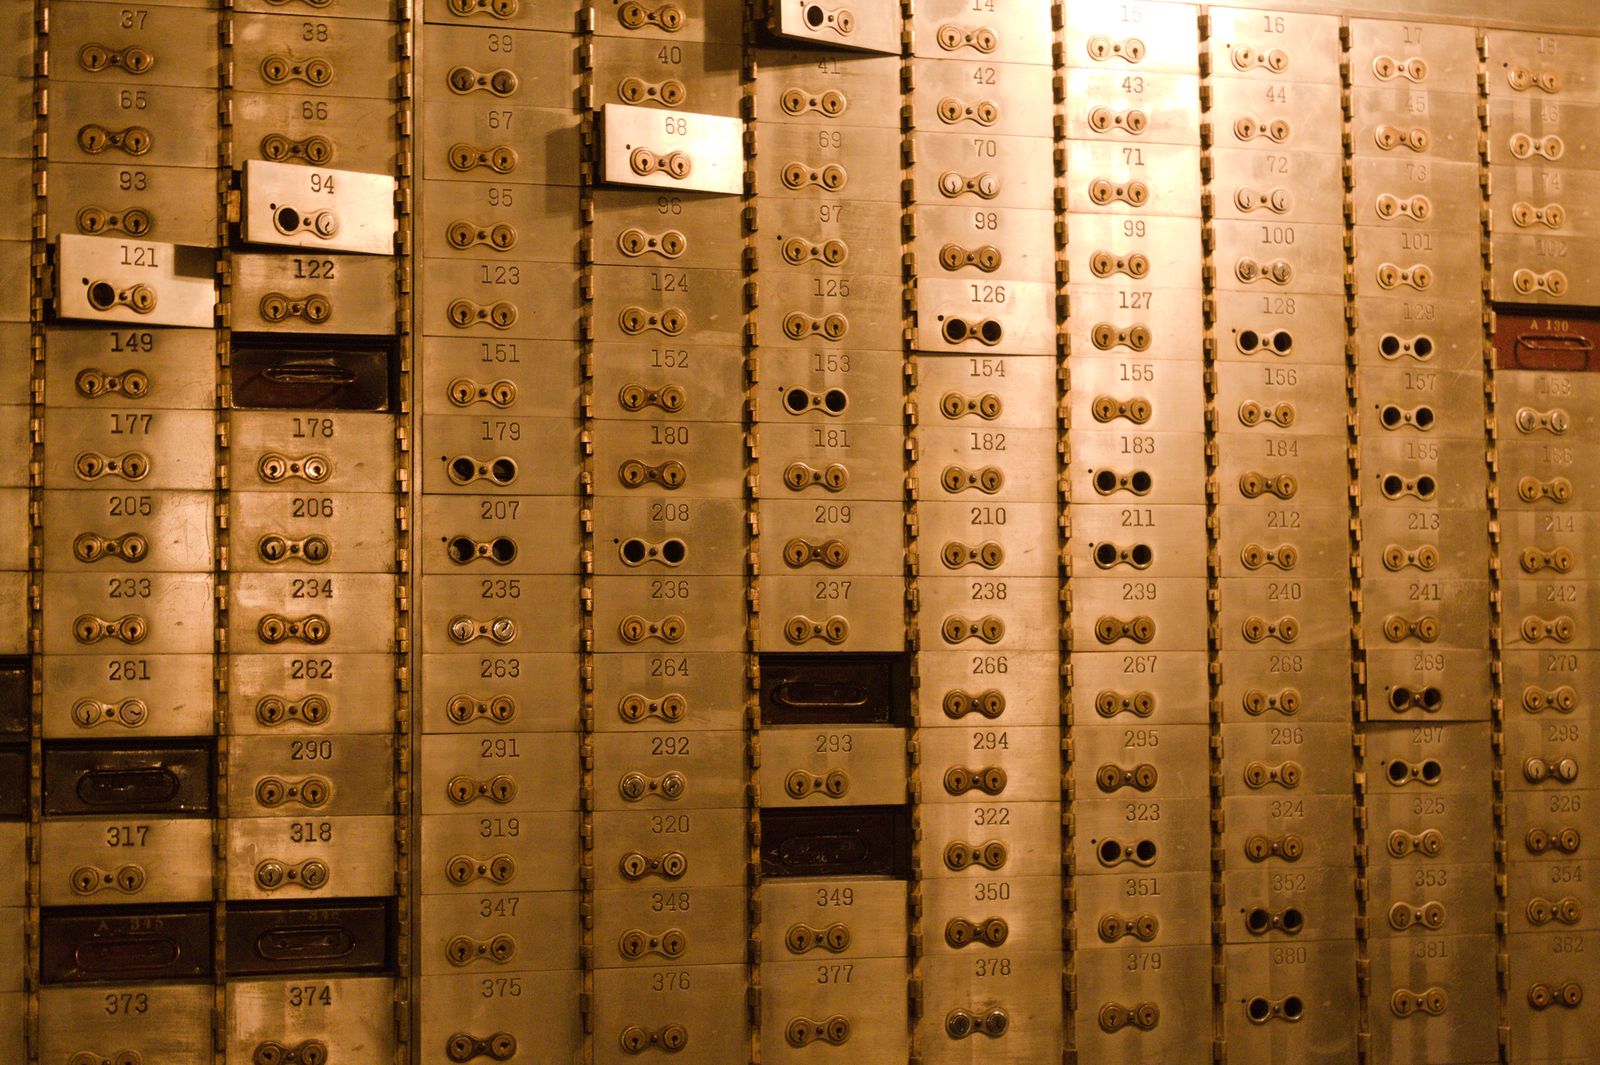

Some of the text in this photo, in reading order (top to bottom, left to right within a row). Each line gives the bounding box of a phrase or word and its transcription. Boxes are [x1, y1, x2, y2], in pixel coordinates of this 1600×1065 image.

[120, 11, 148, 30] 37
[1121, 6, 1142, 23] 15
[302, 23, 328, 42] 38
[1263, 16, 1285, 34] 16
[488, 35, 513, 54] 39
[1403, 27, 1423, 44] 17
[1536, 38, 1557, 55] 18
[657, 47, 683, 65] 40
[817, 57, 841, 76] 41
[973, 68, 996, 85] 42
[1122, 77, 1144, 94] 43
[120, 91, 147, 110] 65
[1265, 87, 1287, 104] 44
[302, 102, 328, 120] 66
[1406, 97, 1426, 114] 45
[488, 112, 513, 130] 67
[664, 118, 687, 136] 68
[819, 132, 842, 149] 69
[973, 140, 997, 157] 70
[1123, 148, 1145, 166] 71
[1266, 157, 1289, 174] 72
[119, 172, 147, 191] 93
[1407, 166, 1427, 182] 73
[1541, 173, 1561, 190] 74
[310, 174, 335, 195] 94
[488, 189, 513, 207] 95
[657, 197, 682, 216] 96
[819, 205, 843, 223] 97
[974, 213, 998, 230] 98
[1123, 221, 1146, 238] 99
[1262, 227, 1295, 244] 100
[1402, 234, 1433, 251] 101
[120, 246, 159, 268] 121
[293, 260, 335, 280] 122
[481, 267, 520, 286] 123
[651, 274, 689, 293] 124
[813, 280, 850, 298] 125
[970, 285, 1006, 303] 126
[1118, 292, 1153, 310] 127
[1263, 298, 1296, 315] 128
[1403, 304, 1436, 321] 129
[1530, 320, 1539, 331] A
[110, 334, 153, 353] 149
[481, 344, 520, 363] 151
[651, 350, 689, 369] 152
[814, 354, 850, 373] 153
[970, 359, 1005, 377] 154
[1119, 364, 1154, 382] 155
[1264, 369, 1297, 386] 156
[1405, 373, 1436, 391] 157
[110, 414, 153, 434] 177
[292, 418, 334, 438] 178
[481, 422, 521, 441] 179
[651, 427, 689, 446] 180
[814, 430, 851, 448] 181
[970, 433, 1006, 451] 182
[1121, 437, 1155, 454] 183
[1266, 440, 1299, 458] 184
[1407, 443, 1439, 461] 185
[109, 497, 153, 517] 205
[292, 499, 334, 518] 206
[481, 501, 520, 521] 207
[651, 504, 690, 522] 208
[815, 506, 852, 524] 209
[970, 508, 1007, 525] 210
[1121, 509, 1155, 528] 211
[1267, 512, 1301, 529] 212
[1408, 513, 1440, 531] 213
[1544, 516, 1575, 533] 214
[109, 579, 152, 599] 233
[292, 580, 334, 599] 234
[481, 580, 521, 599] 235
[651, 581, 690, 600] 236
[815, 582, 852, 600] 237
[971, 583, 1007, 601] 238
[1122, 583, 1157, 601] 239
[1268, 584, 1302, 601] 240
[1409, 584, 1441, 601] 241
[1545, 586, 1576, 603] 242
[108, 661, 151, 681] 261
[291, 660, 333, 680] 262
[480, 660, 520, 679] 263
[651, 658, 689, 677] 264
[973, 657, 1008, 675] 266
[1123, 656, 1158, 674] 267
[1269, 656, 1303, 674] 268
[1413, 654, 1445, 672] 269
[1546, 655, 1578, 671] 270
[973, 732, 1009, 751] 294
[1124, 730, 1159, 748] 295
[1270, 728, 1304, 745] 296
[1412, 727, 1443, 744] 297
[1548, 725, 1579, 742] 298
[290, 740, 333, 760] 290
[481, 739, 520, 758] 291
[651, 737, 690, 756] 292
[816, 735, 853, 754] 293
[1125, 804, 1161, 822] 323
[1271, 801, 1305, 819] 324
[1413, 798, 1446, 816] 325
[1550, 796, 1581, 813] 326
[652, 815, 690, 834] 320
[974, 808, 1009, 826] 322
[106, 826, 149, 847] 317
[290, 823, 332, 843] 318
[480, 819, 520, 838] 319
[1272, 874, 1307, 892] 352
[1415, 870, 1448, 887] 353
[1551, 866, 1583, 883] 354
[974, 883, 1010, 902] 350
[1126, 878, 1161, 897] 351
[651, 893, 690, 912] 348
[816, 888, 854, 908] 349
[480, 898, 520, 917] 347
[1416, 941, 1448, 958] 381
[1552, 936, 1584, 954] 382
[1127, 953, 1162, 971] 379
[1274, 947, 1307, 965] 380
[817, 965, 854, 984] 377
[975, 959, 1011, 977] 378
[481, 978, 521, 998] 375
[652, 972, 690, 992] 376
[105, 994, 149, 1015] 373
[289, 986, 332, 1007] 374
